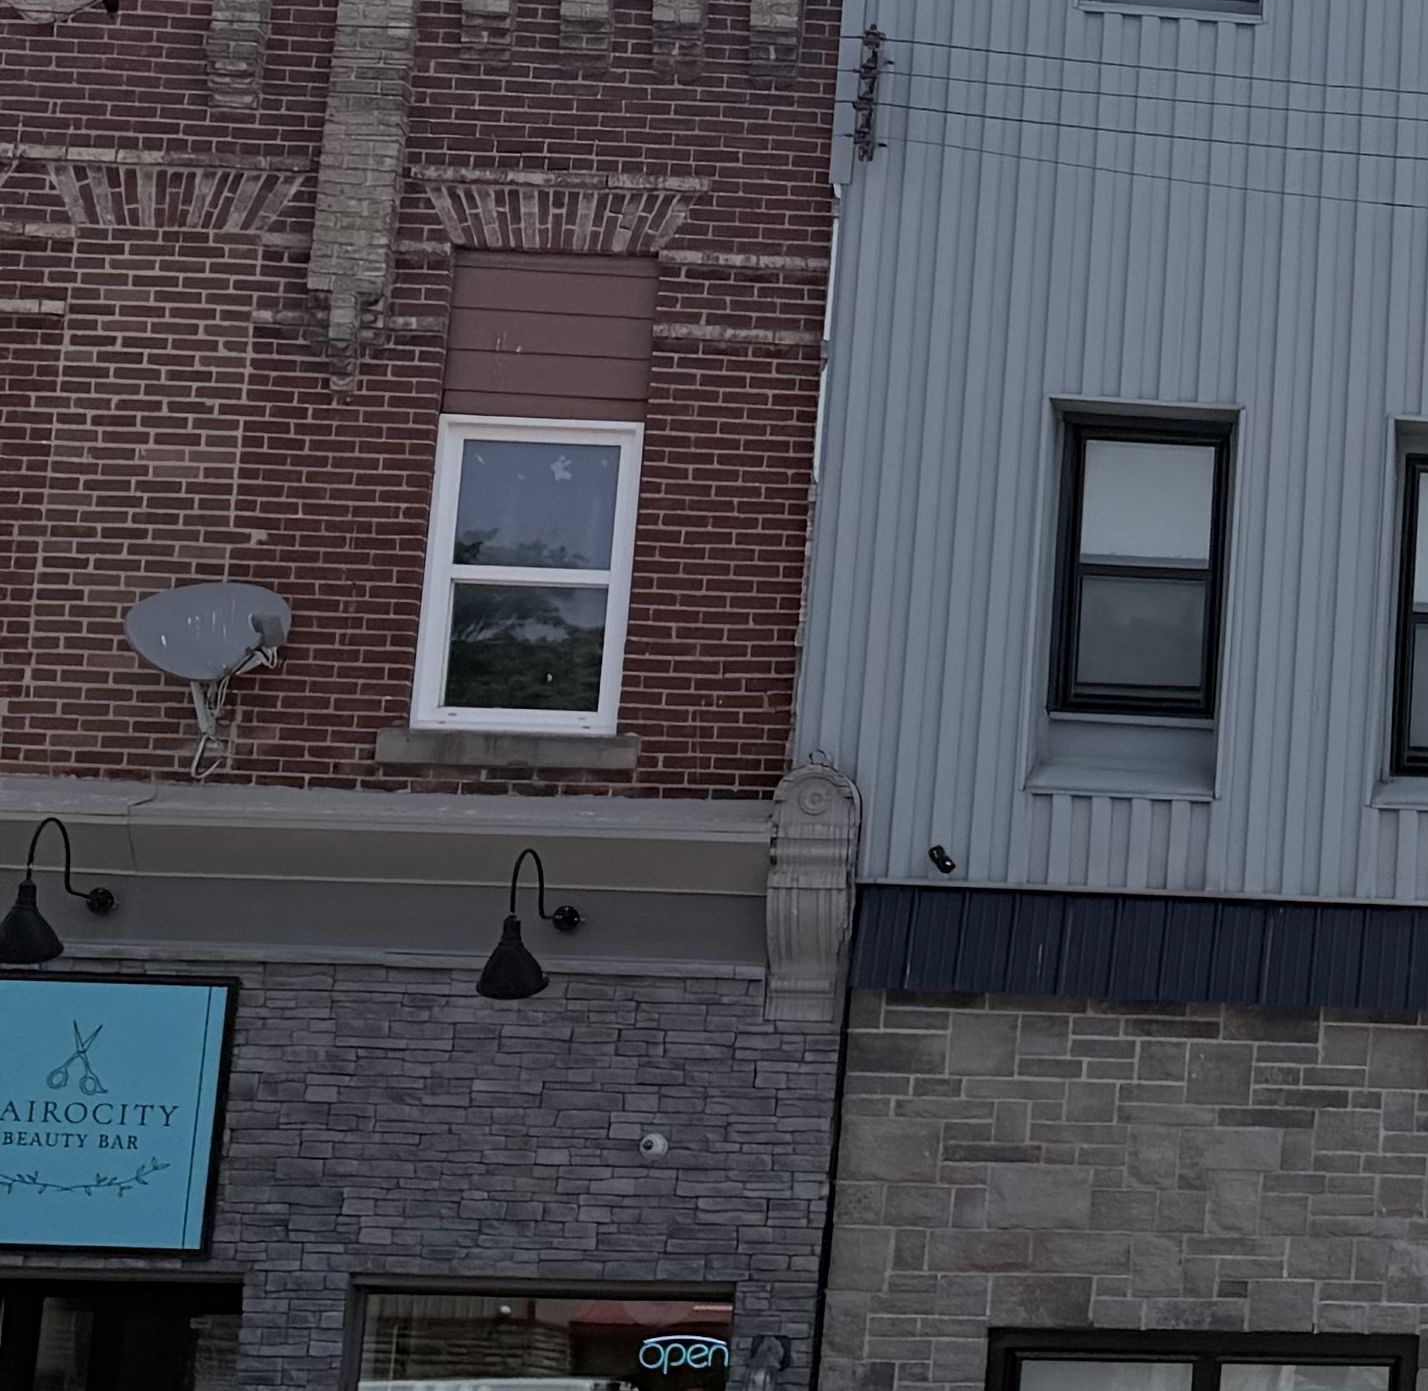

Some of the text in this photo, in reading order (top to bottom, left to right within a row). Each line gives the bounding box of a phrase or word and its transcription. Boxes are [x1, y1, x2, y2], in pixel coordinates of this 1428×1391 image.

[2, 1131, 139, 1150] BEAUTY BAR
[638, 1343, 729, 1375] open
